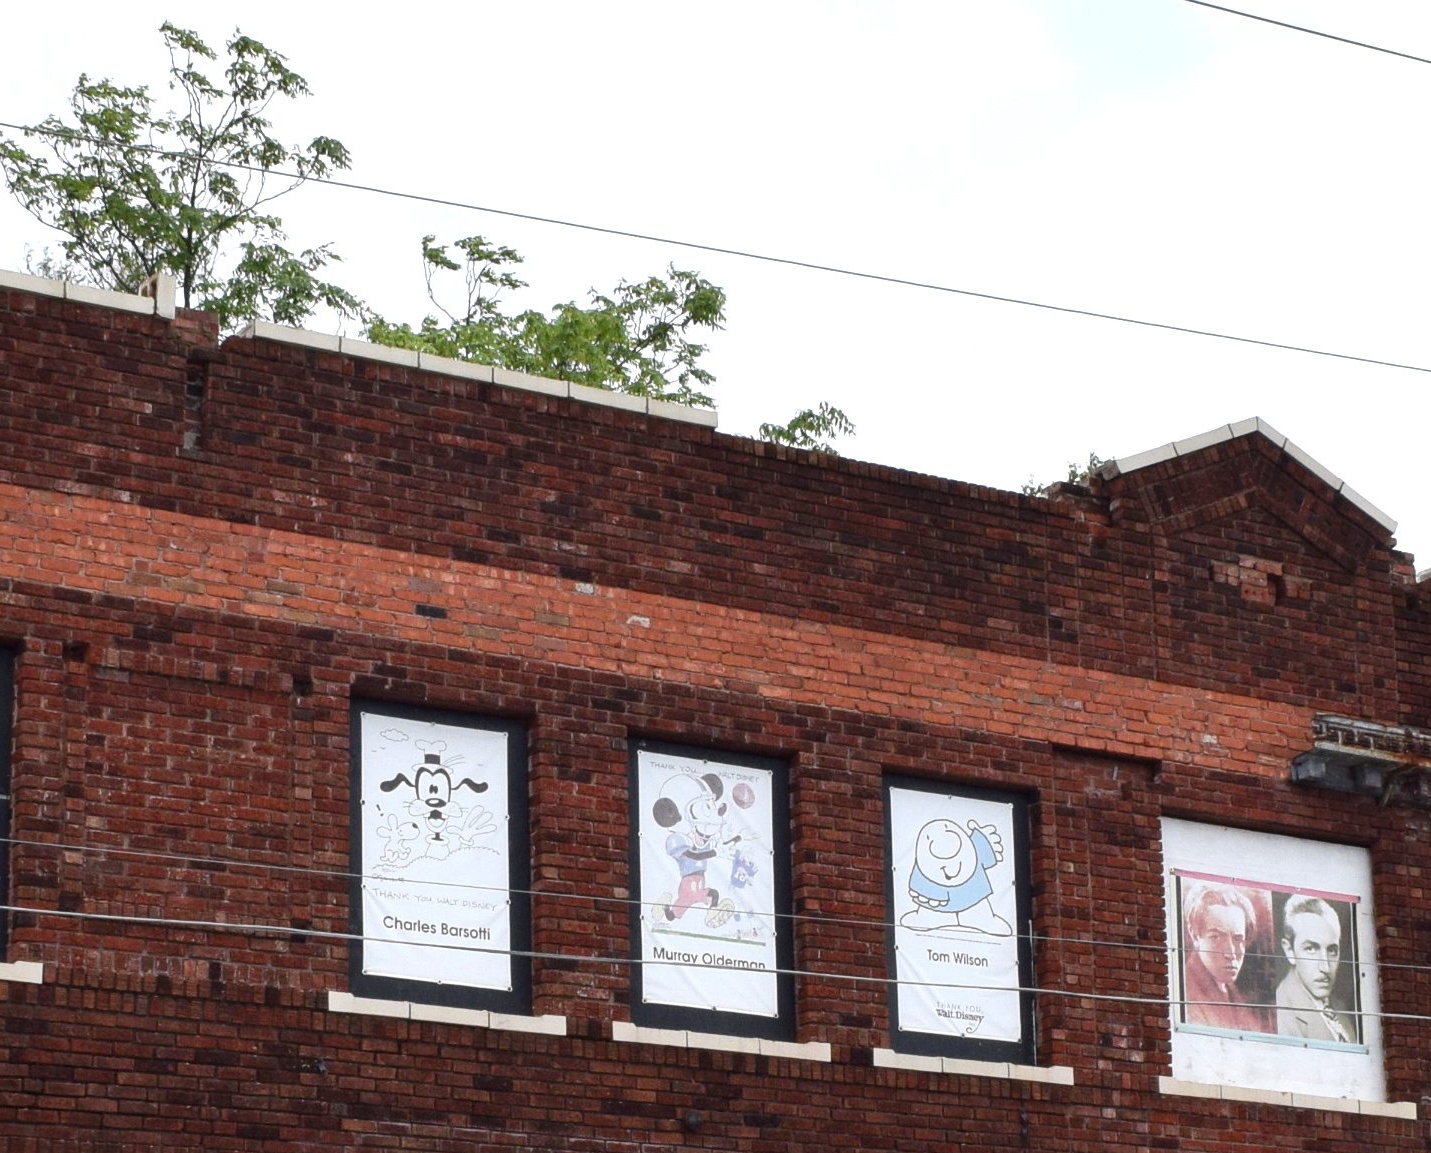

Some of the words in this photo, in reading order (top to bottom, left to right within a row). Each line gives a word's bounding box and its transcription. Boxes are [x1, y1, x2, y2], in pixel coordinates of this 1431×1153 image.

[372, 887, 410, 901] THANK
[414, 894, 433, 903] YOU
[436, 897, 459, 906] WALT
[462, 900, 497, 912] DISNEY
[382, 915, 437, 934] Charles
[441, 922, 491, 941] Barsotti
[653, 946, 698, 963] Murray
[702, 952, 766, 970] Olderman
[927, 949, 950, 962] Tom
[952, 952, 989, 967] Wilson
[936, 1001, 961, 1010] THANK
